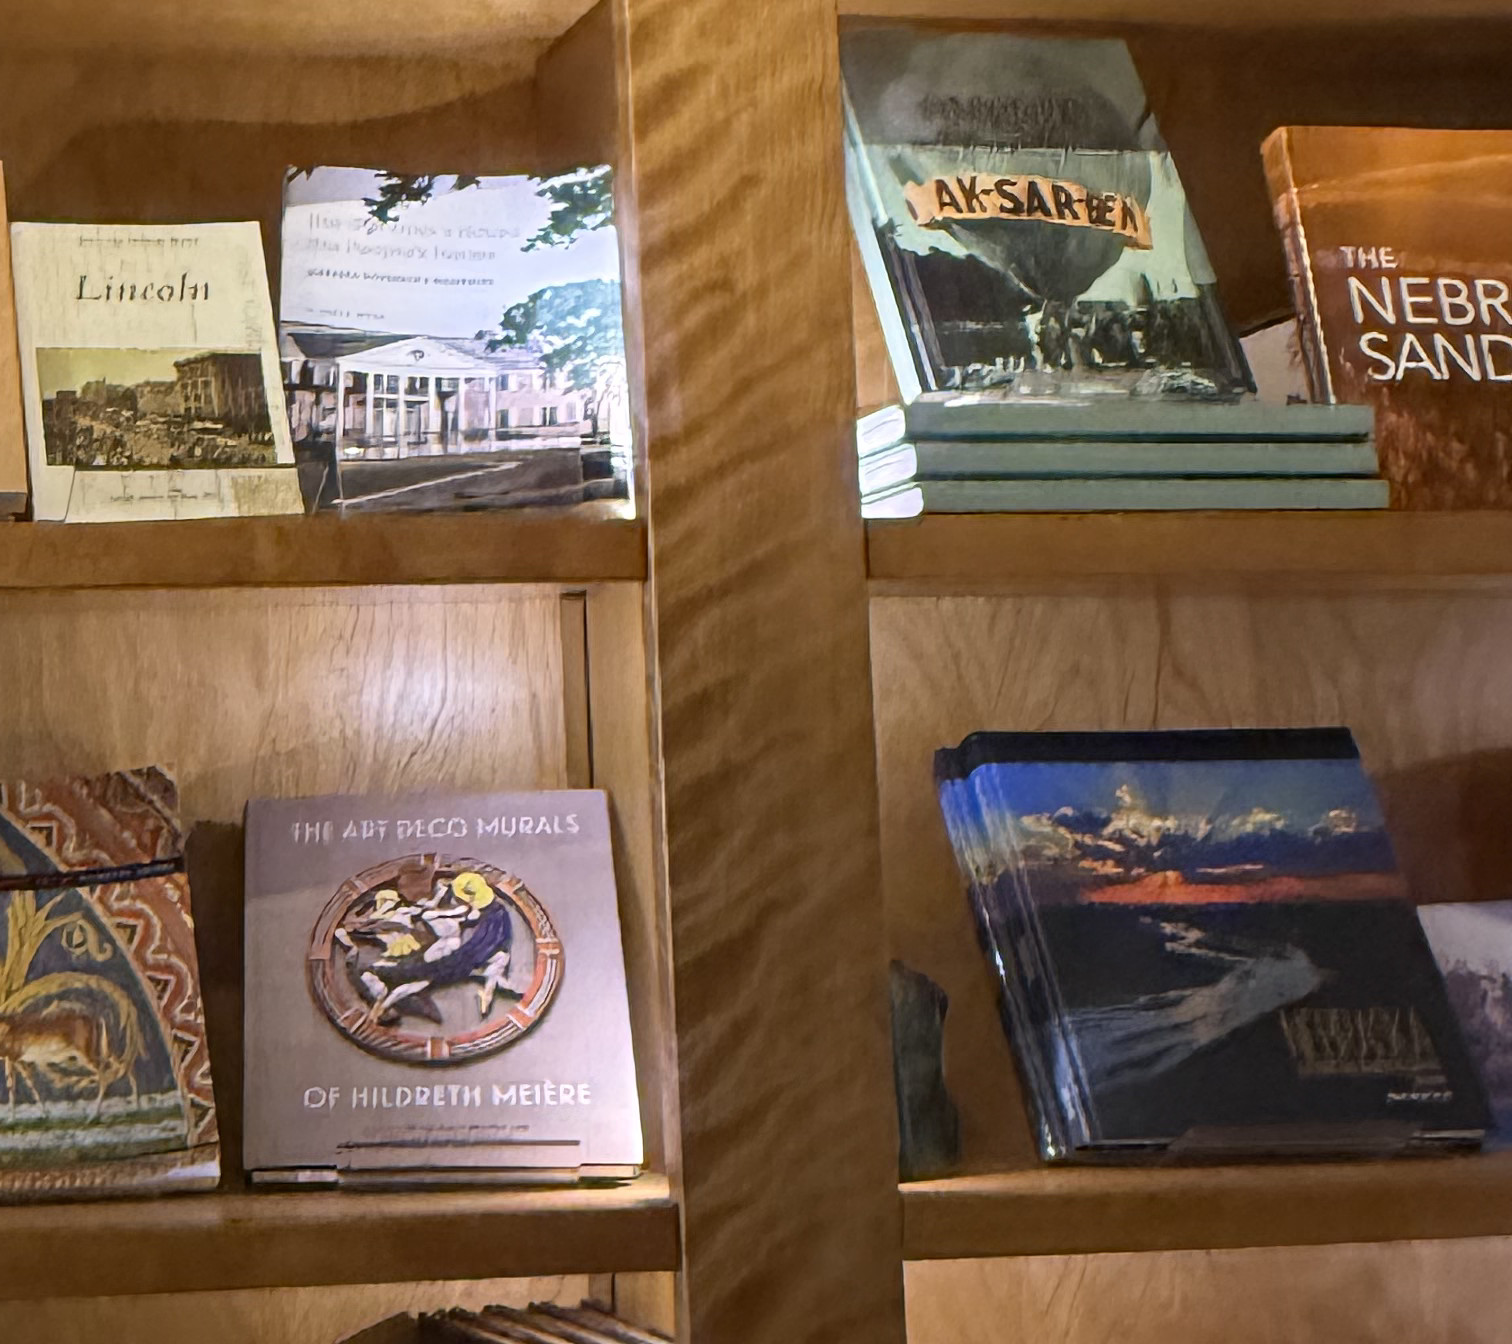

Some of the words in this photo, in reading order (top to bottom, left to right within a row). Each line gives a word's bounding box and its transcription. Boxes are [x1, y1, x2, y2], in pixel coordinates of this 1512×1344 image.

[934, 175, 1140, 233] AK-SAR-BEN
[1340, 245, 1399, 269] THE
[76, 272, 210, 303] Lincoln
[342, 820, 389, 840] ART
[396, 817, 468, 839] DECO
[476, 814, 580, 838] MURALS
[303, 1086, 340, 1110] OF
[351, 1085, 482, 1109] HILDRETH
[492, 1079, 592, 1107] MEIÈRE
